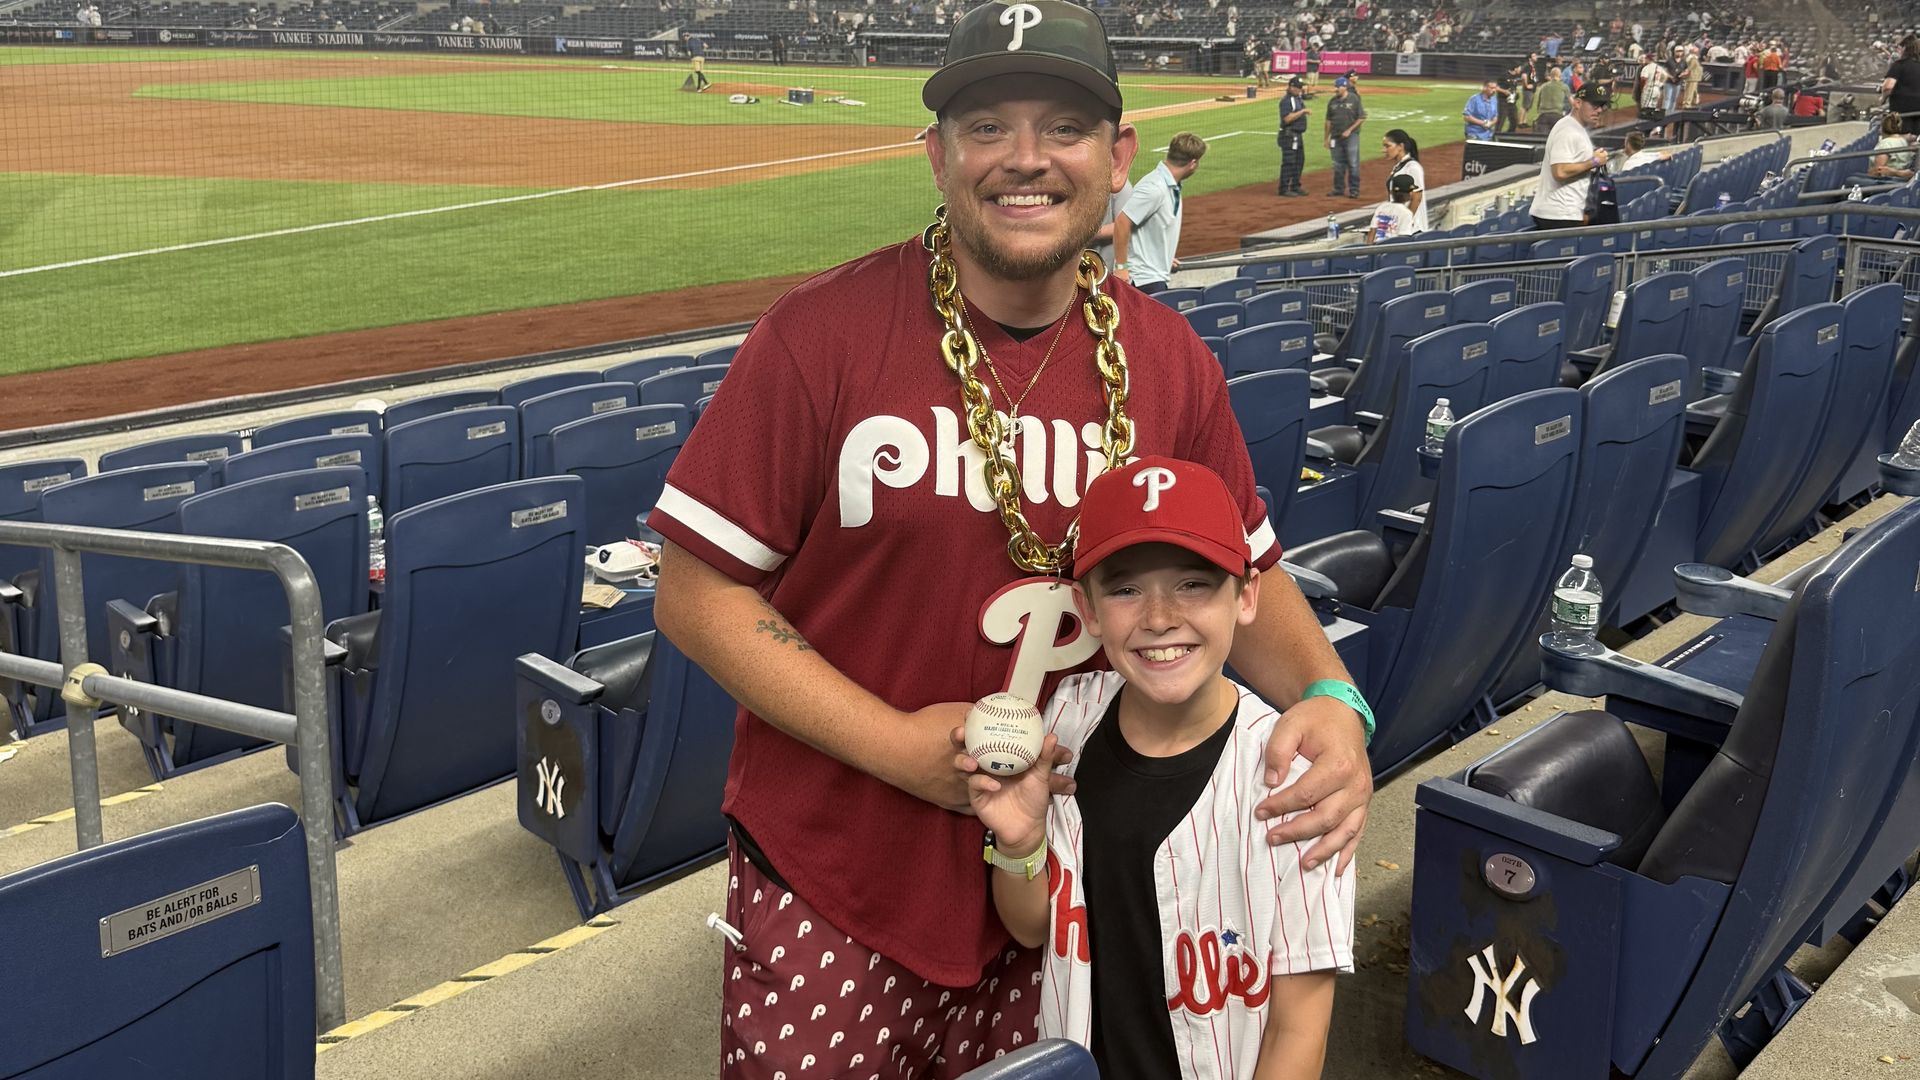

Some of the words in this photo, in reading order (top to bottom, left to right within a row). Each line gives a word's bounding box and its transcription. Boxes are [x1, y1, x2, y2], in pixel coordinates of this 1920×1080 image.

[272, 32, 312, 44] YANKEE
[318, 33, 364, 45] STADIUM
[436, 35, 475, 48] YANKEE
[479, 38, 522, 50] STADIUM
[999, 3, 1042, 51] P
[1464, 160, 1487, 175] city
[1132, 466, 1177, 512] P
[1504, 869, 1517, 885] 7
[128, 921, 157, 941] BATS
[159, 905, 204, 930] AND/OR
[206, 892, 238, 913] BALLS
[146, 907, 160, 921] BE
[164, 894, 196, 915] ALERT
[200, 886, 220, 902] FOR
[1463, 943, 1541, 1045] NY
